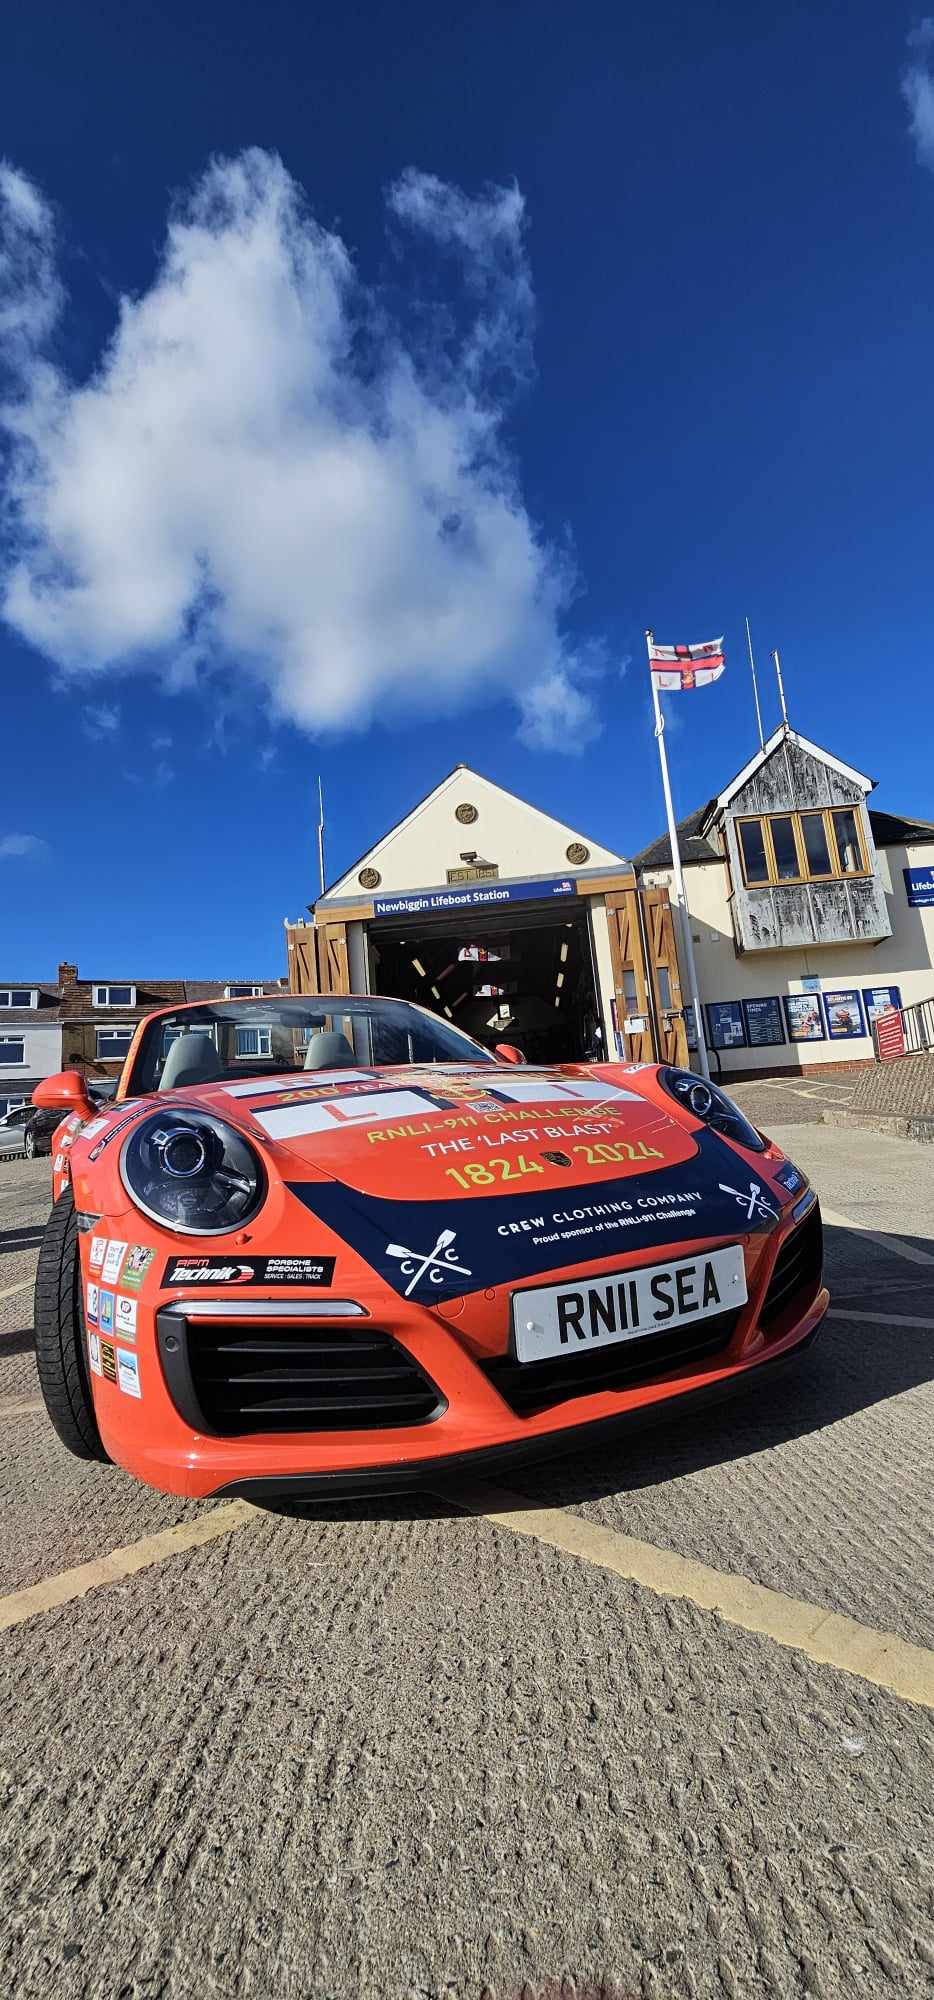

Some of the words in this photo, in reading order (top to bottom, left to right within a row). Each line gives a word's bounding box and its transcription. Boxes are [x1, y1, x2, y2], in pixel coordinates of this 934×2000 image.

[377, 899, 428, 913] Newbiggin
[431, 893, 472, 907] Lifeboat
[473, 889, 510, 901] Station
[277, 1085, 340, 1102] 200
[321, 1103, 378, 1122] L
[367, 1115, 478, 1144] RNLI-911
[483, 1105, 624, 1124] CHALLENGE
[420, 1137, 475, 1158] THE
[444, 1154, 546, 1190] 1824
[572, 1141, 664, 1165] 2024
[497, 1217, 545, 1236] CREW
[552, 1200, 632, 1223] CLOTHING
[637, 1191, 703, 1208] COMPANY
[532, 1232, 560, 1245] Proud
[560, 1226, 594, 1239] sponsor
[595, 1222, 605, 1231] of
[606, 1219, 619, 1229] the
[620, 1213, 657, 1227] RNLI-911
[656, 1207, 696, 1220] Challenge
[169, 1267, 237, 1281] Technik
[650, 1261, 721, 1321] SEA
